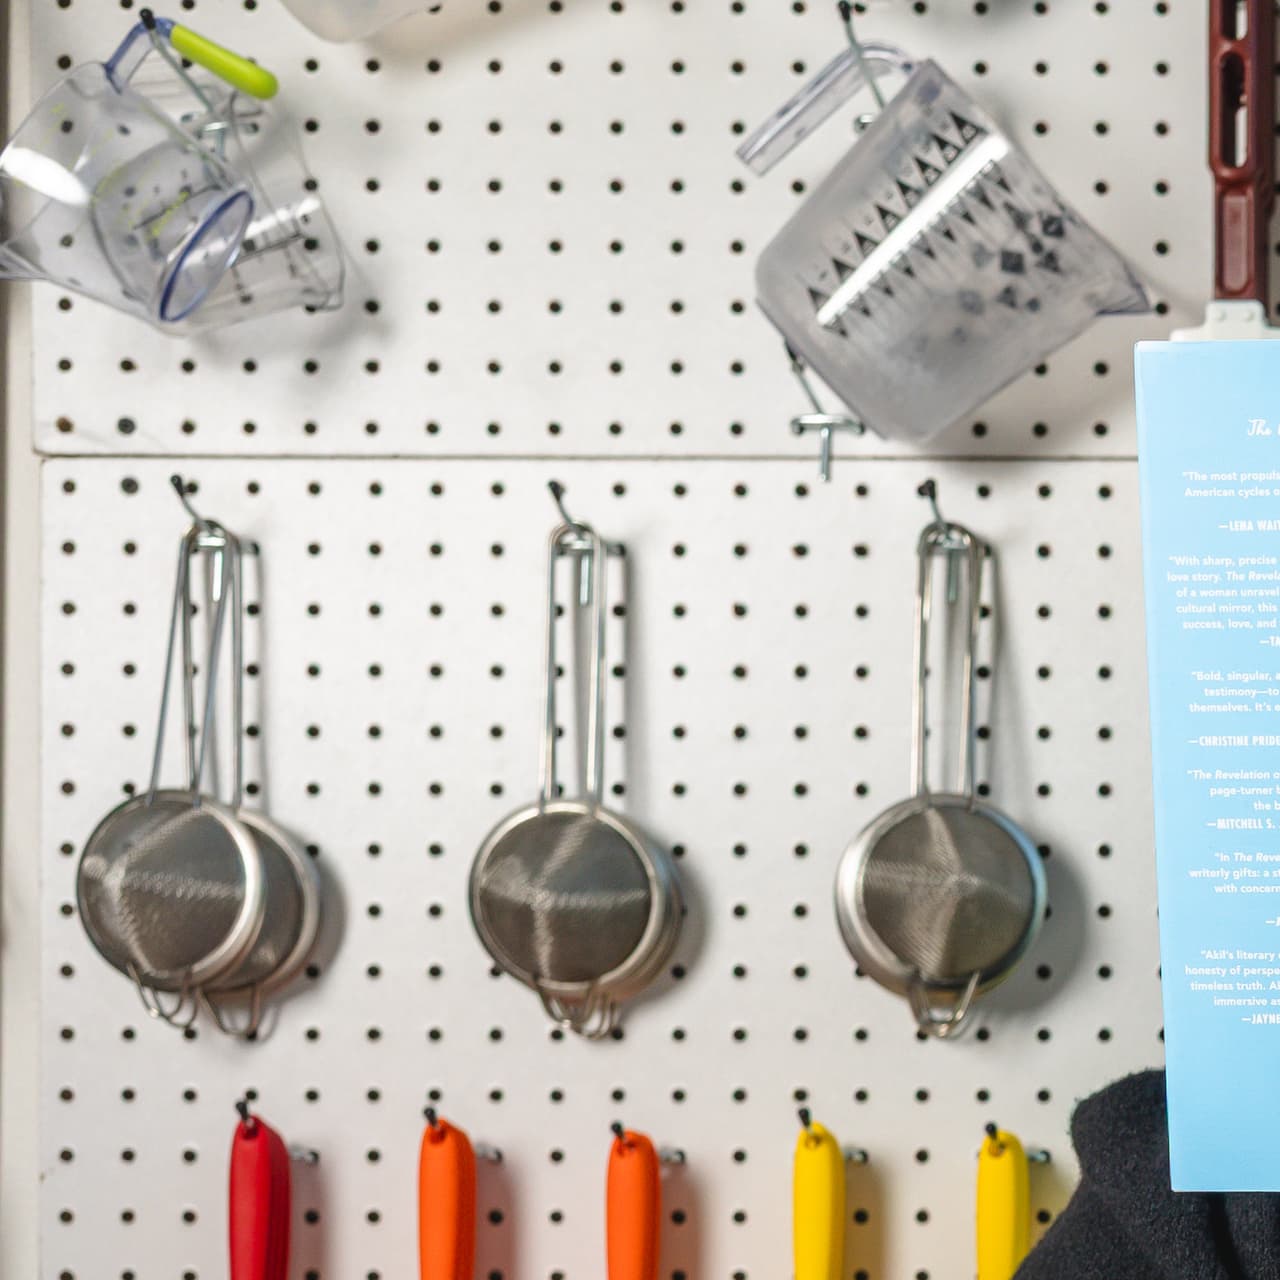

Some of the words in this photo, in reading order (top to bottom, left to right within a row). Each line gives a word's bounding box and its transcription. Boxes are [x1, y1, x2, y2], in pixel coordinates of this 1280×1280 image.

[1247, 418, 1272, 436] The
[1252, 800, 1273, 810] the
[1206, 818, 1263, 829] —MITCHELL
[1265, 818, 1276, 829] S.
